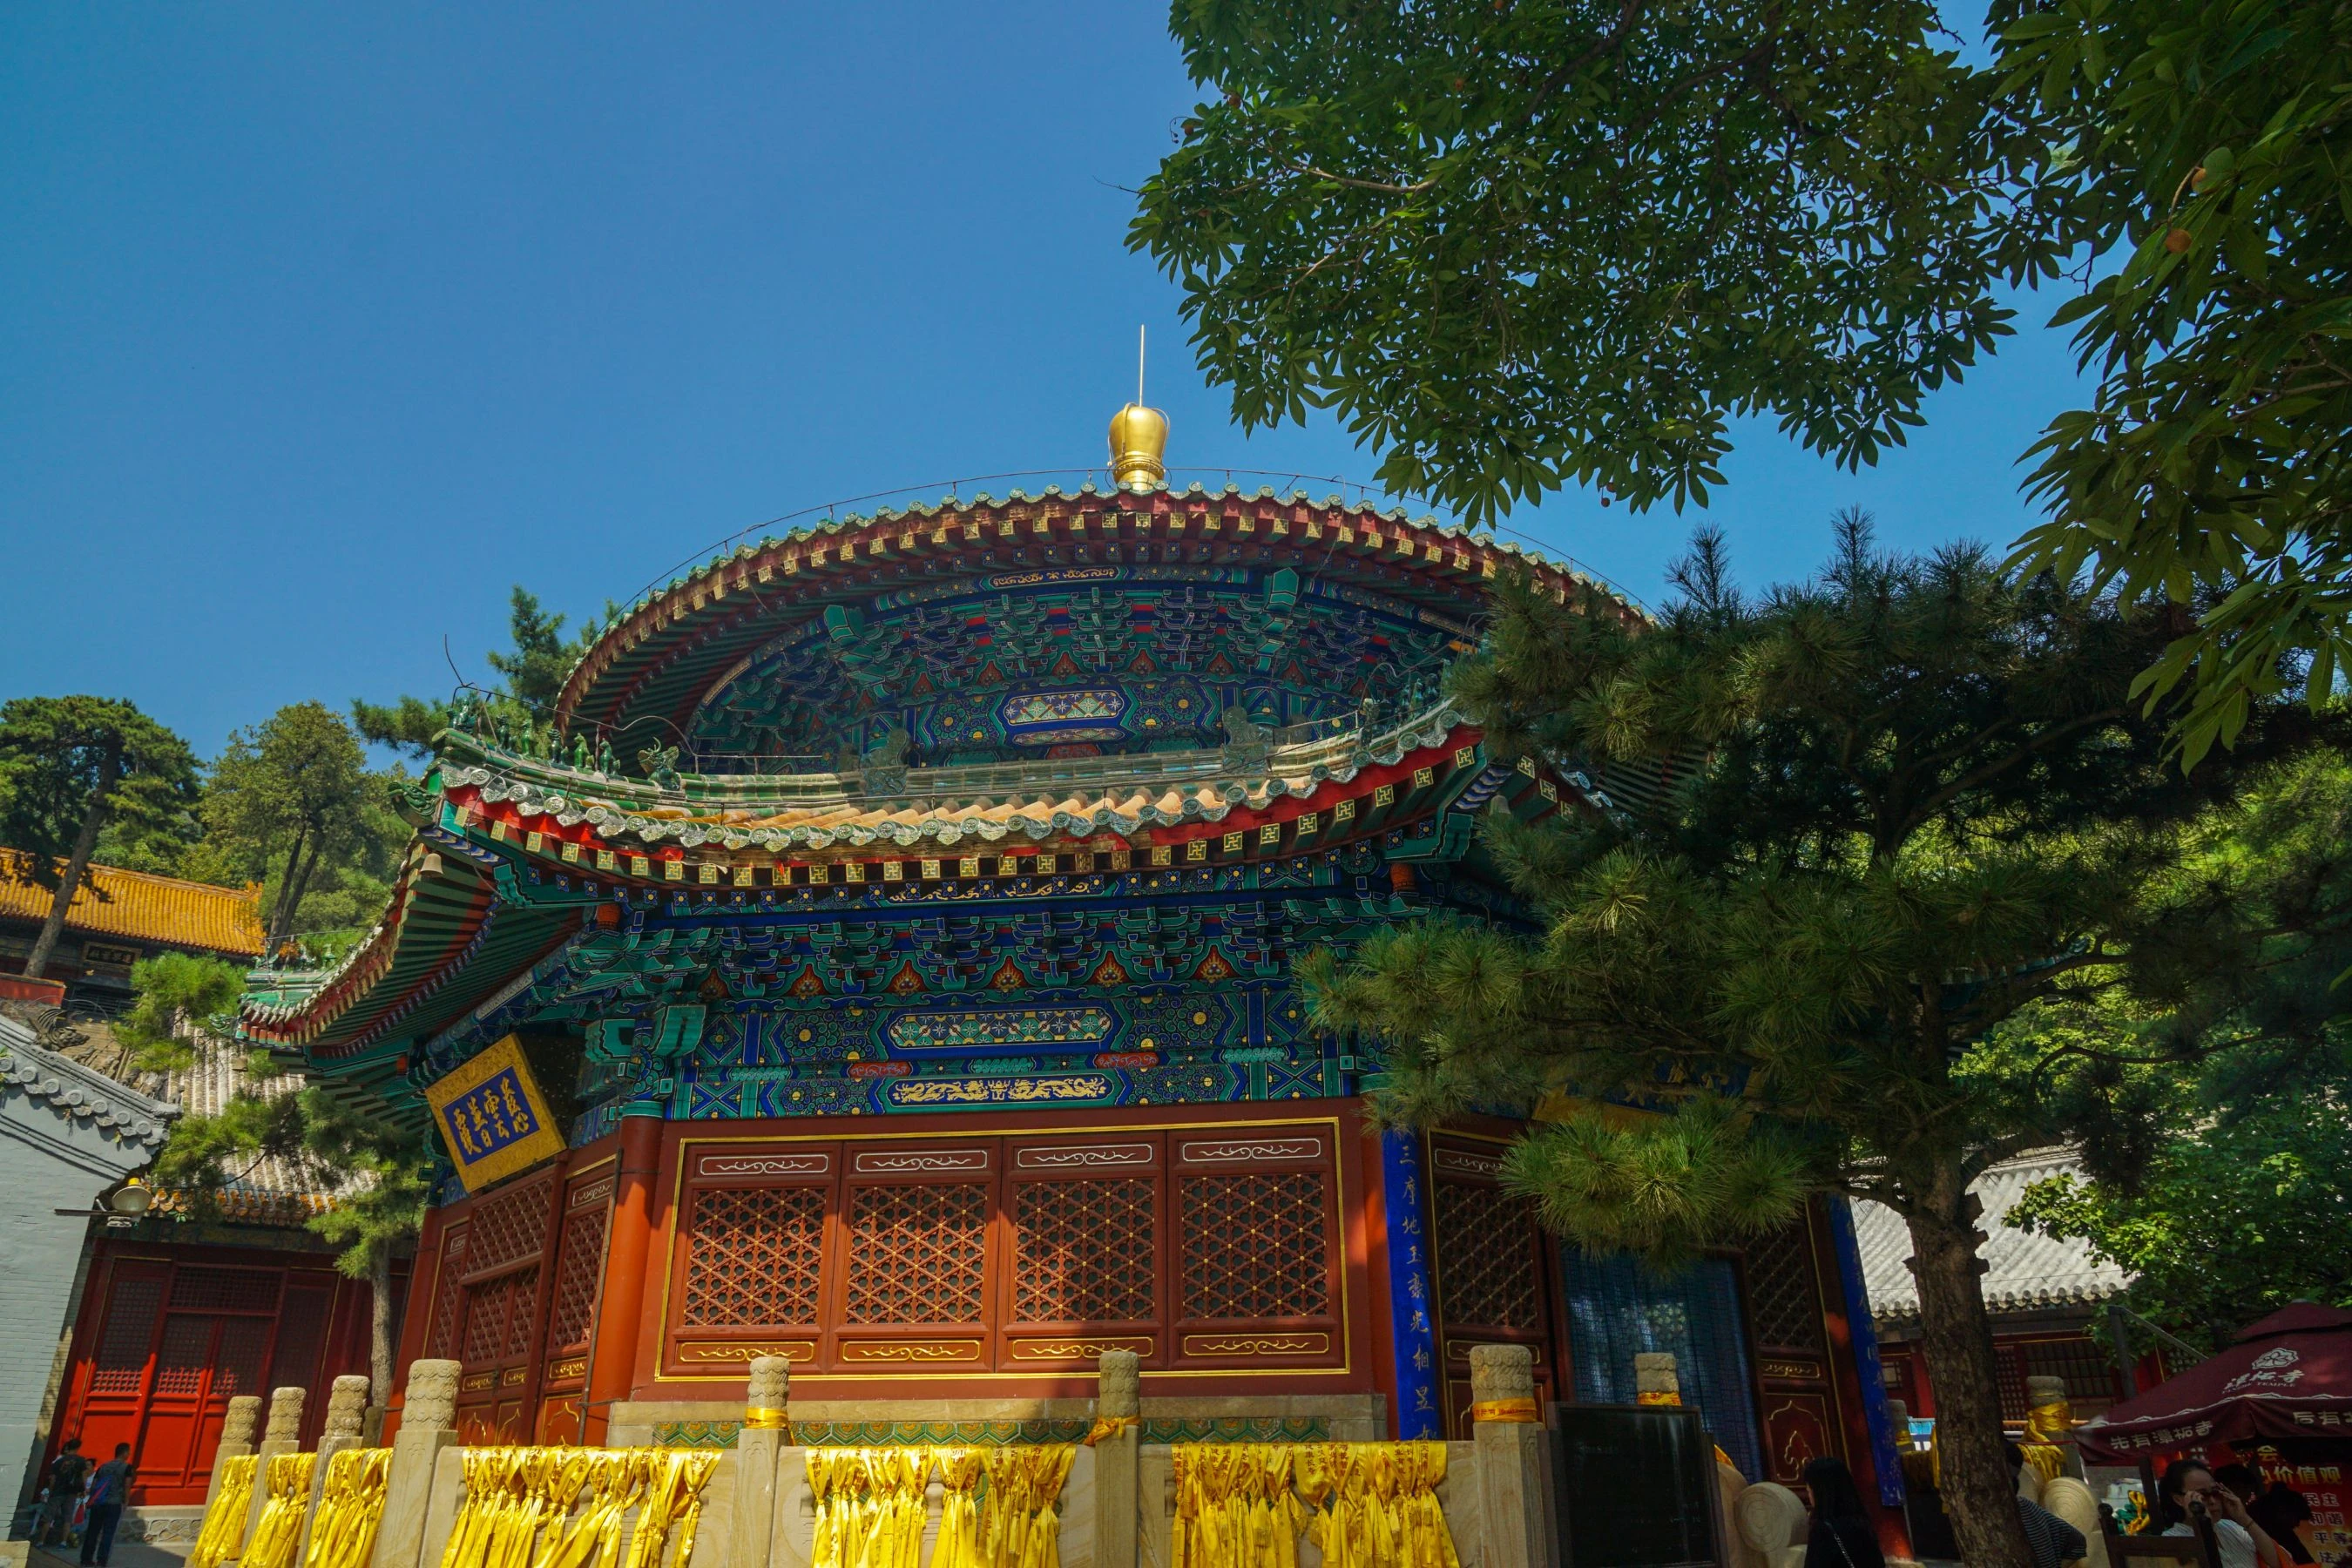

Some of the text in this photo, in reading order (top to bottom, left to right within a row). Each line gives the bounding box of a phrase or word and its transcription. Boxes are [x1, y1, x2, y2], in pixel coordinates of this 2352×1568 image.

[2110, 1420, 2213, 1450] 先有潭柘寺
[2302, 1492, 2340, 1508] 民主
[2308, 1511, 2344, 1526] 和谐
[2314, 1531, 2349, 1546] 平等
